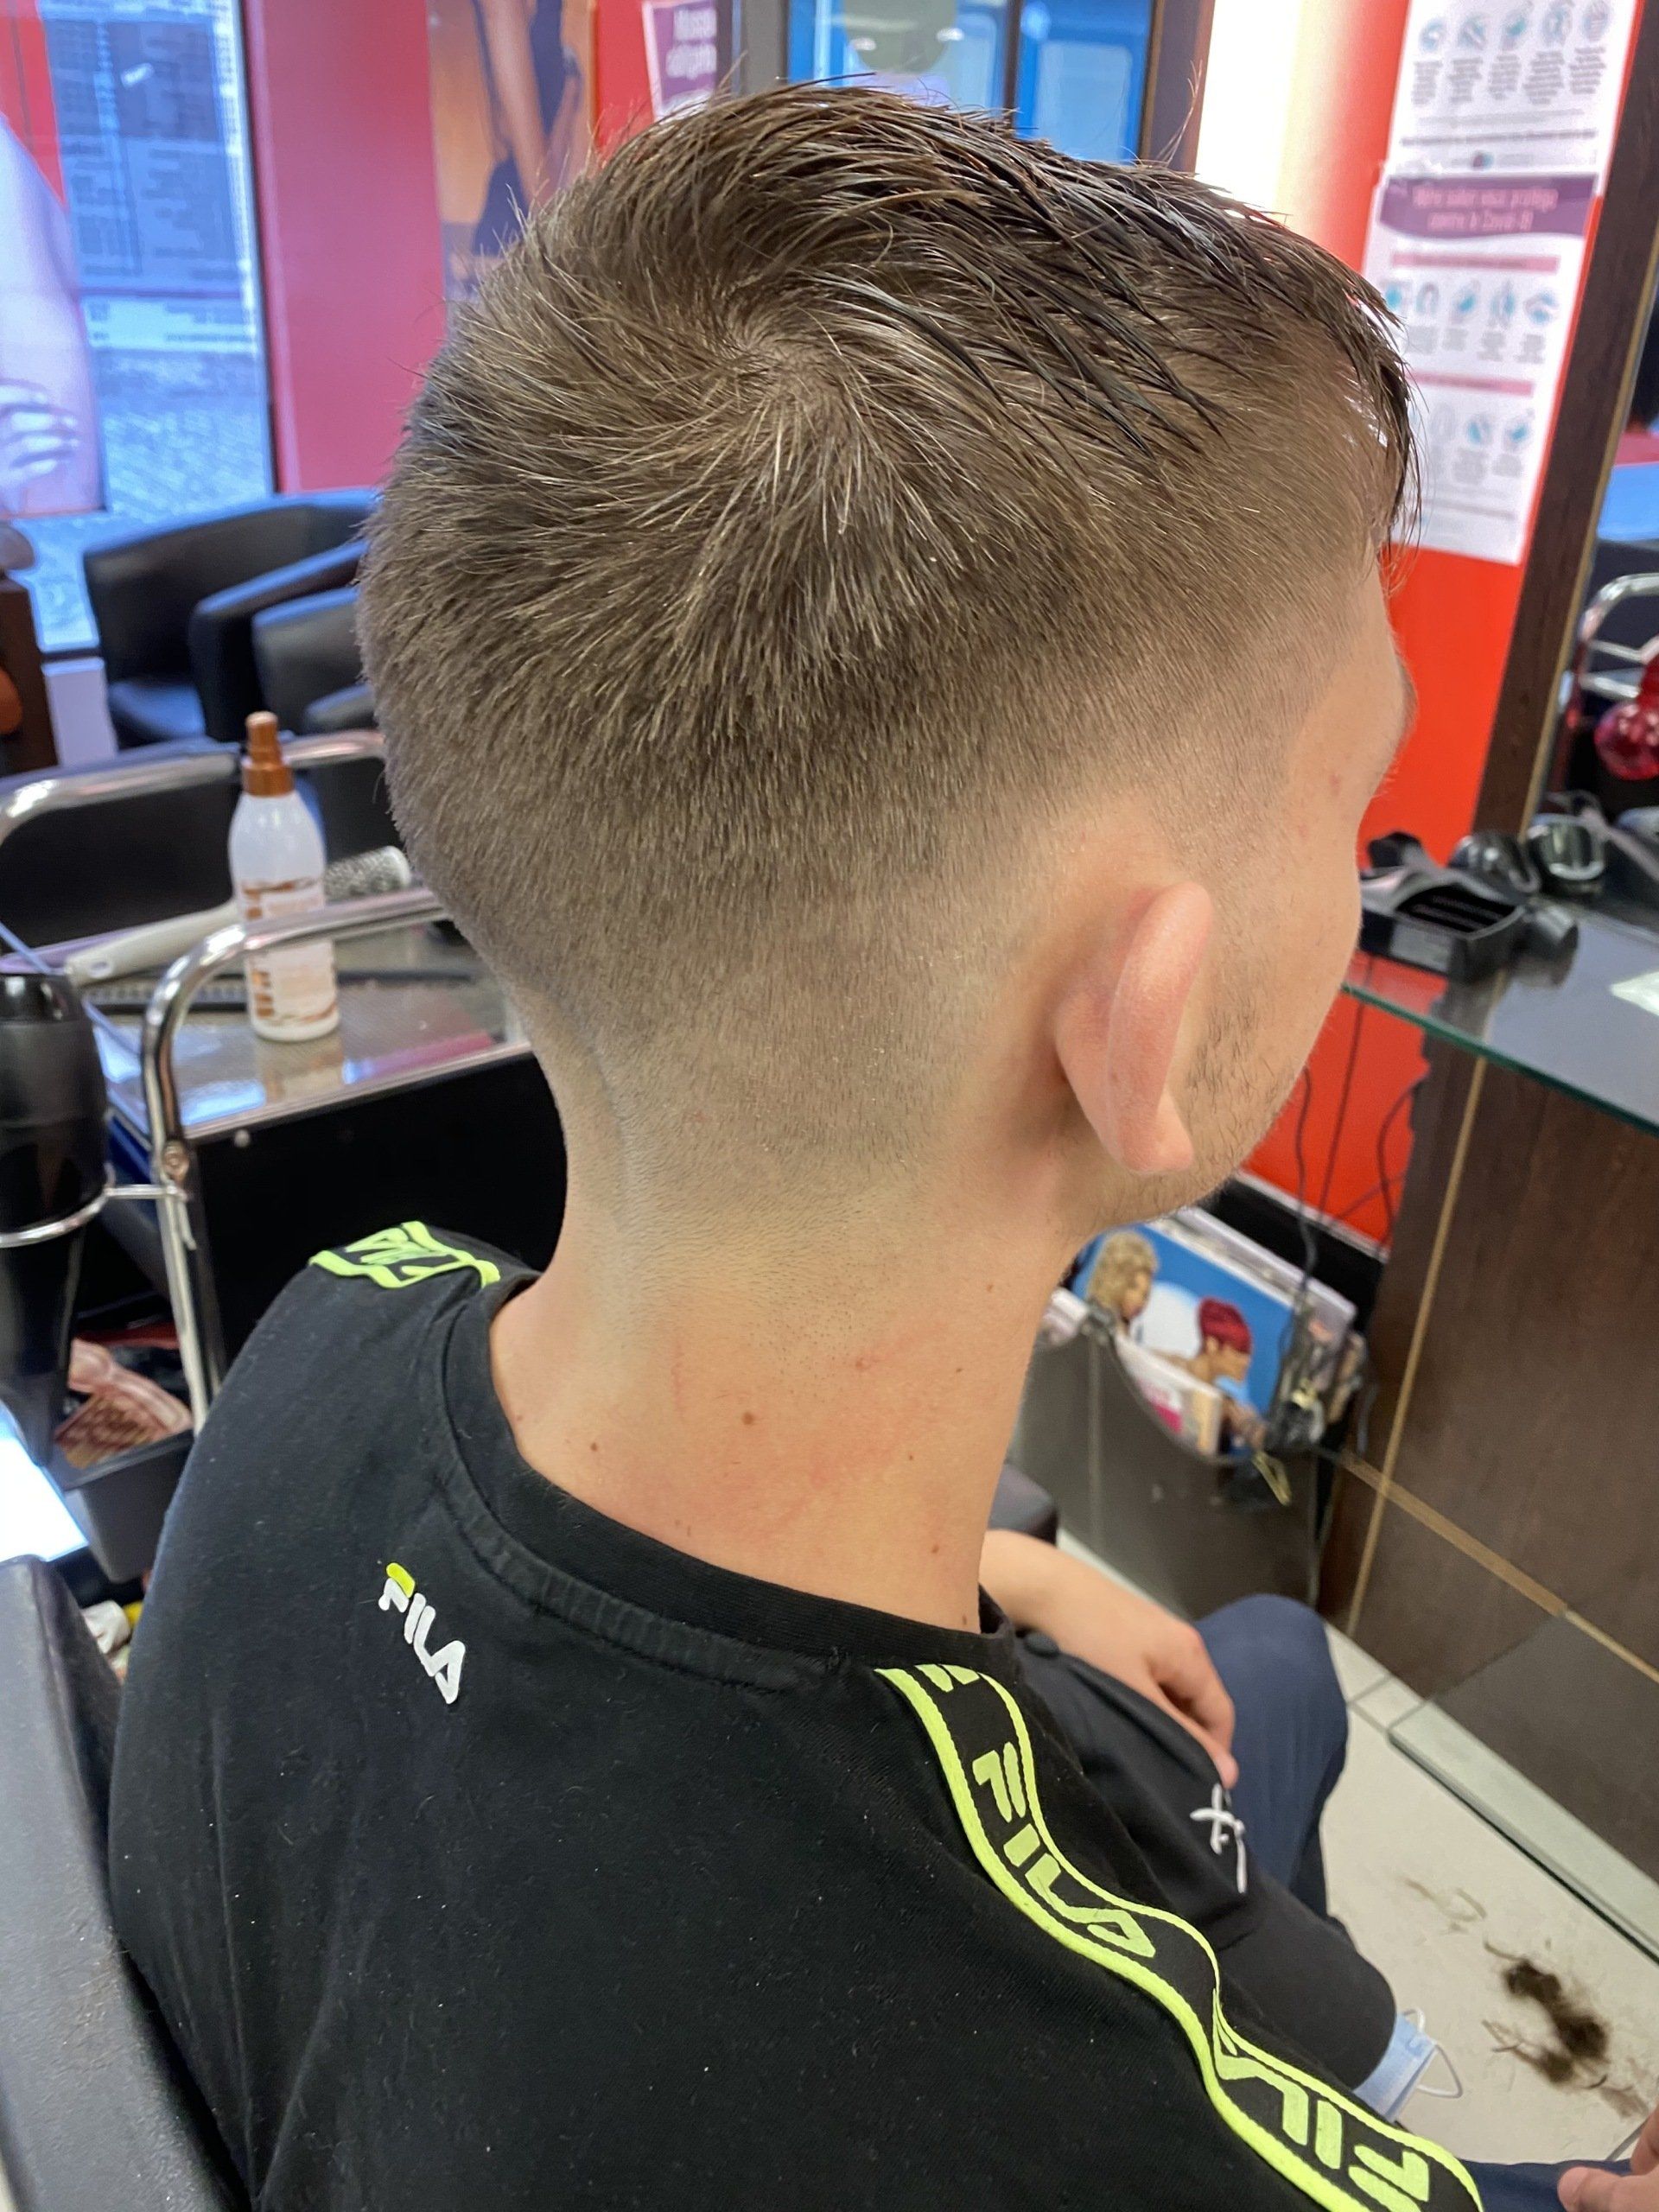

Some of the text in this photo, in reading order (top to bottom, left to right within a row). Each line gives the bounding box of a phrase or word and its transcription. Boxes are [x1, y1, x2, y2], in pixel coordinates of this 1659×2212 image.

[378, 1562, 466, 1705] FILA
[972, 1741, 1156, 1958] FILA
[1211, 1987, 1429, 2212] FILA
